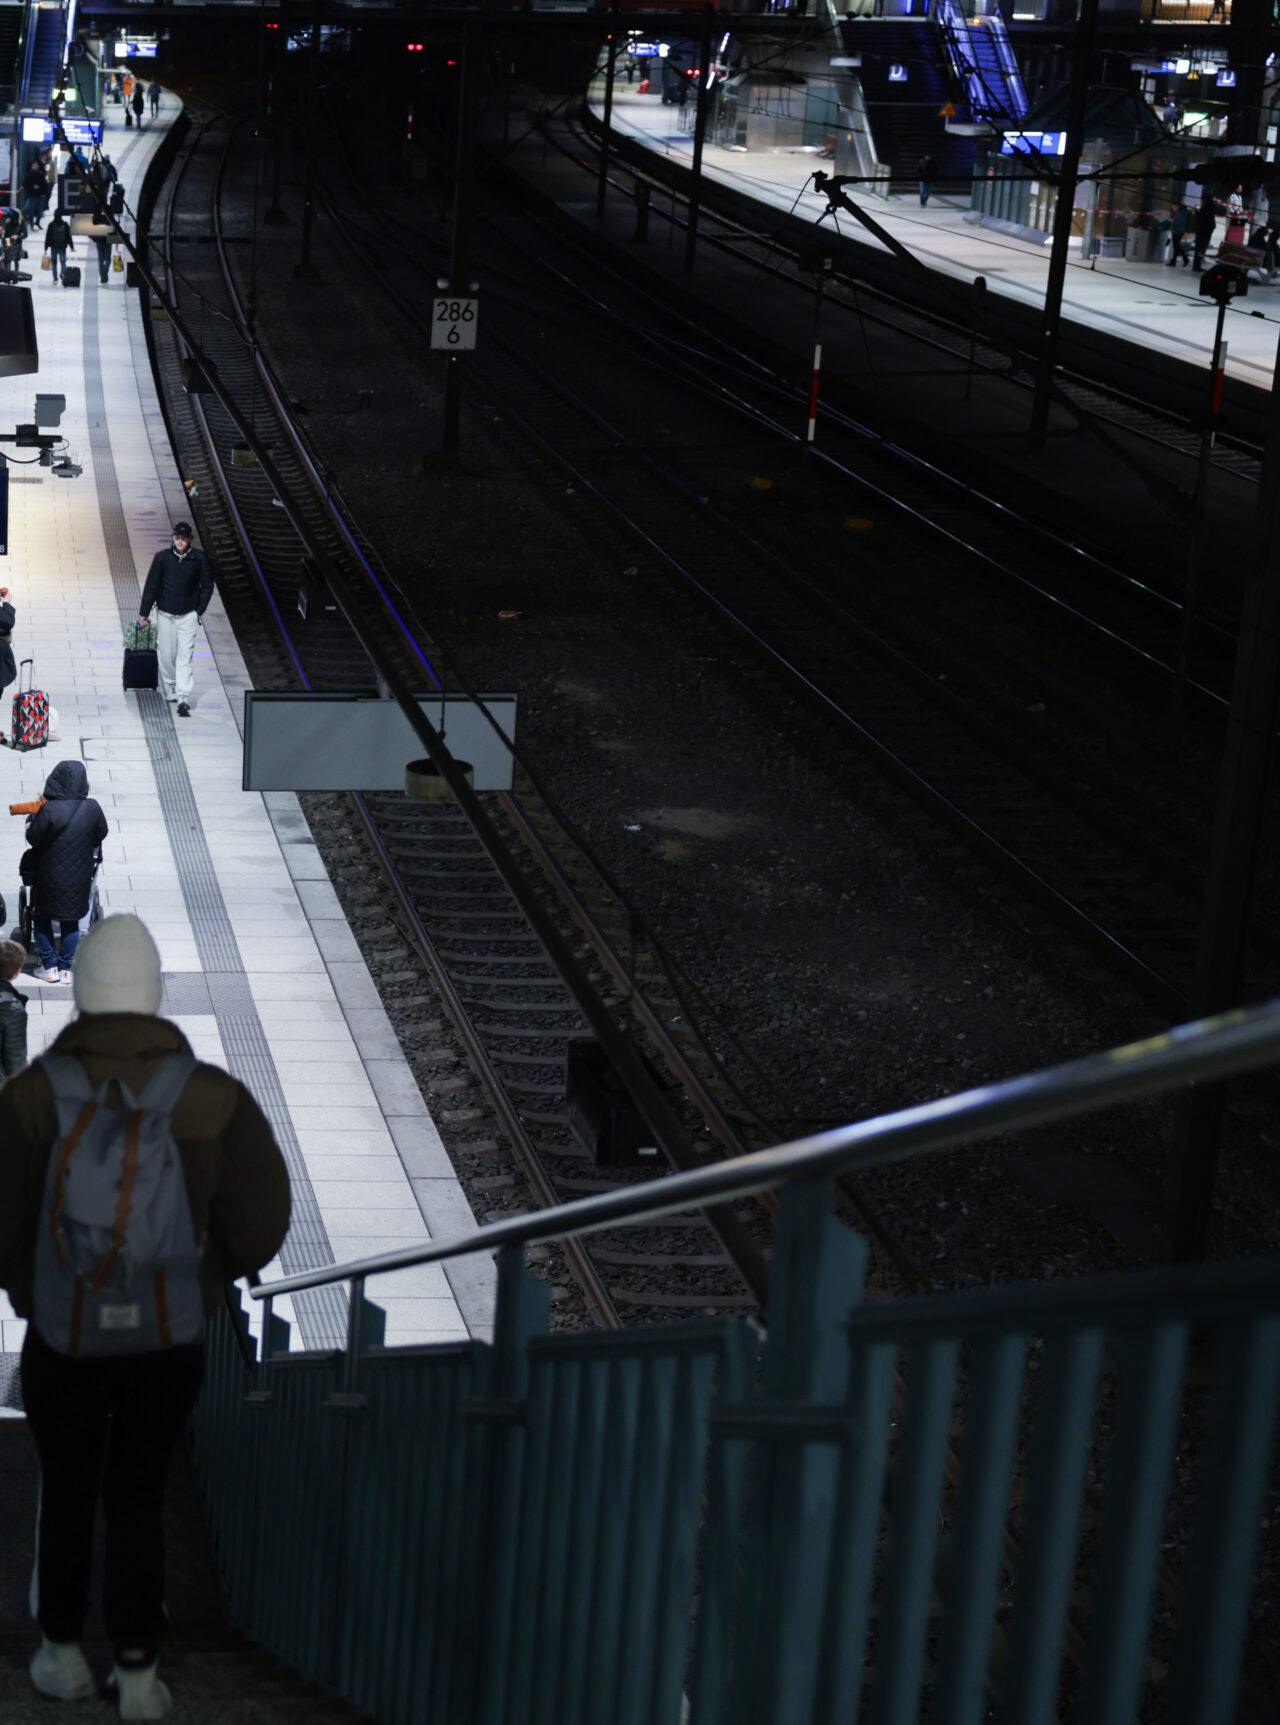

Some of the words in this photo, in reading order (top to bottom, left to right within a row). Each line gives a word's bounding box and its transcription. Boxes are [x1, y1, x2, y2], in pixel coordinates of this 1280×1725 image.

[64, 179, 83, 209] E
[436, 302, 474, 322] 286
[447, 324, 460, 344] 6
[0, 544, 5, 553] 8
